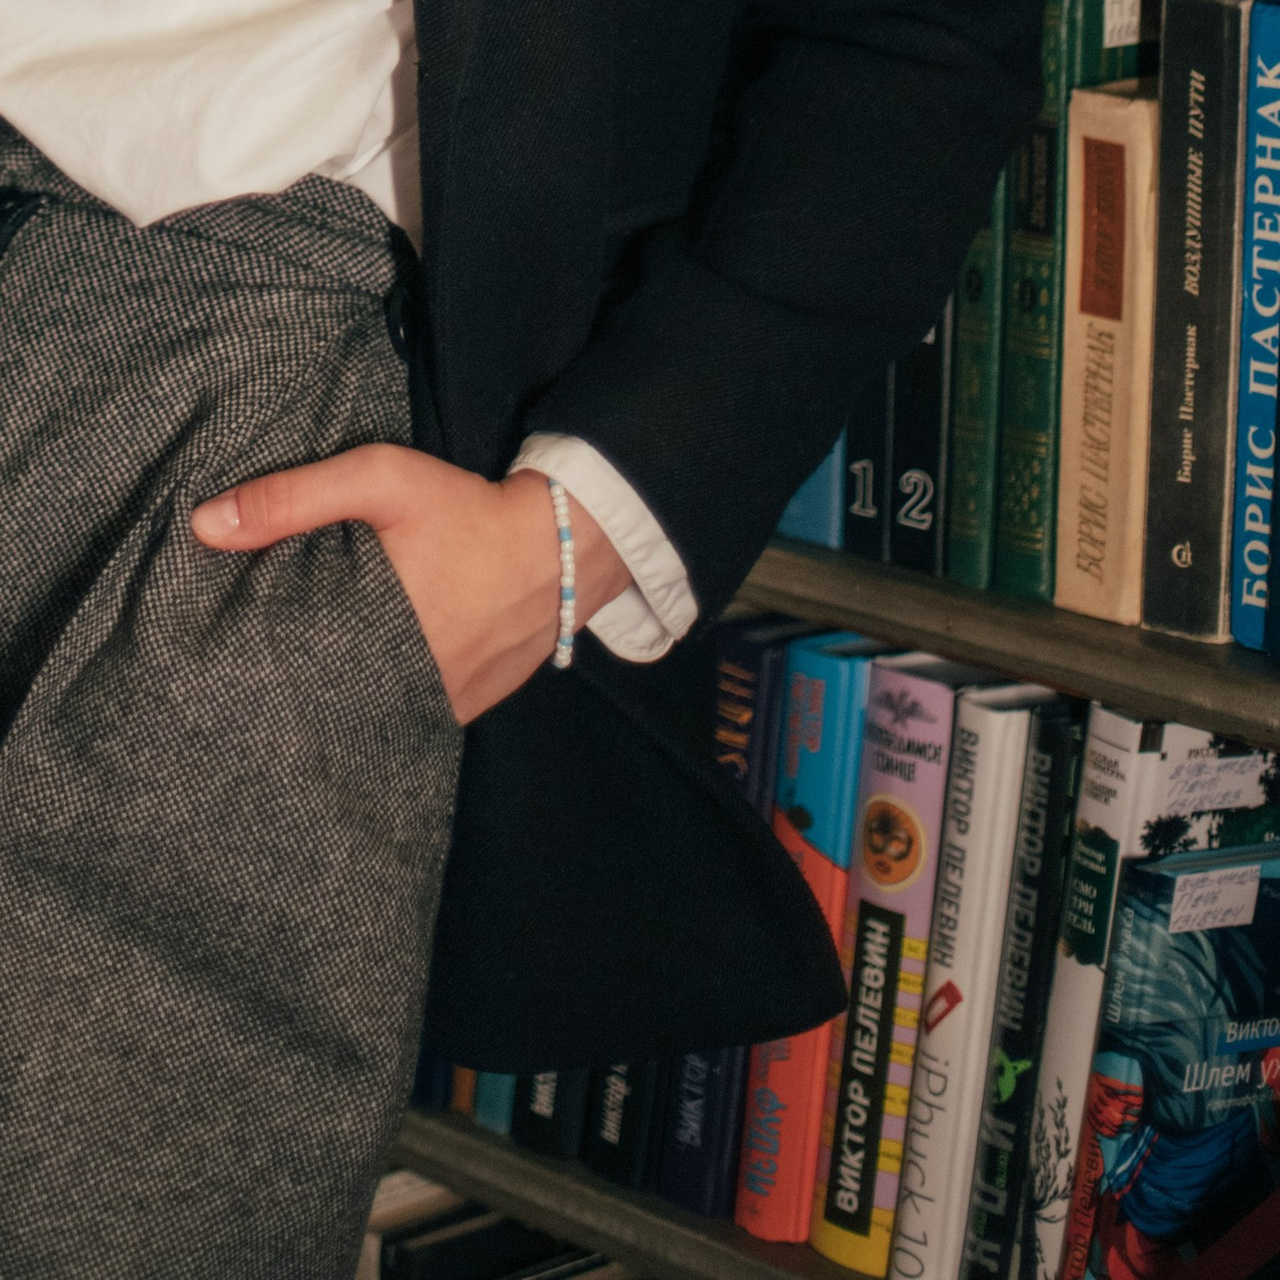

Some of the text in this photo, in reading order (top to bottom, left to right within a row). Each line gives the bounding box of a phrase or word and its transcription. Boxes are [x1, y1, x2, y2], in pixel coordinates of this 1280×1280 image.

[1176, 67, 1206, 484] Борис Пастернак ВОЗДУШНЫЕ ПУТИ
[1240, 54, 1280, 609] БОРИС ПАСТЕРНАК
[849, 458, 879, 519] 1
[896, 469, 935, 532] 2
[1079, 320, 1116, 484] ПАСТЕРНАК
[1074, 483, 1108, 586] БОРИС
[934, 728, 979, 969] ВИКТОР ПЕЛЕВИН
[998, 749, 1053, 1032] ВИКТОР ПЕЛЕВИН
[836, 914, 891, 1215] ВИКТОР ПЕЛЕВИН
[1105, 969, 1126, 1023] Шлем
[1183, 1059, 1252, 1094] Шлем
[893, 1049, 951, 1279] iPhuck 10
